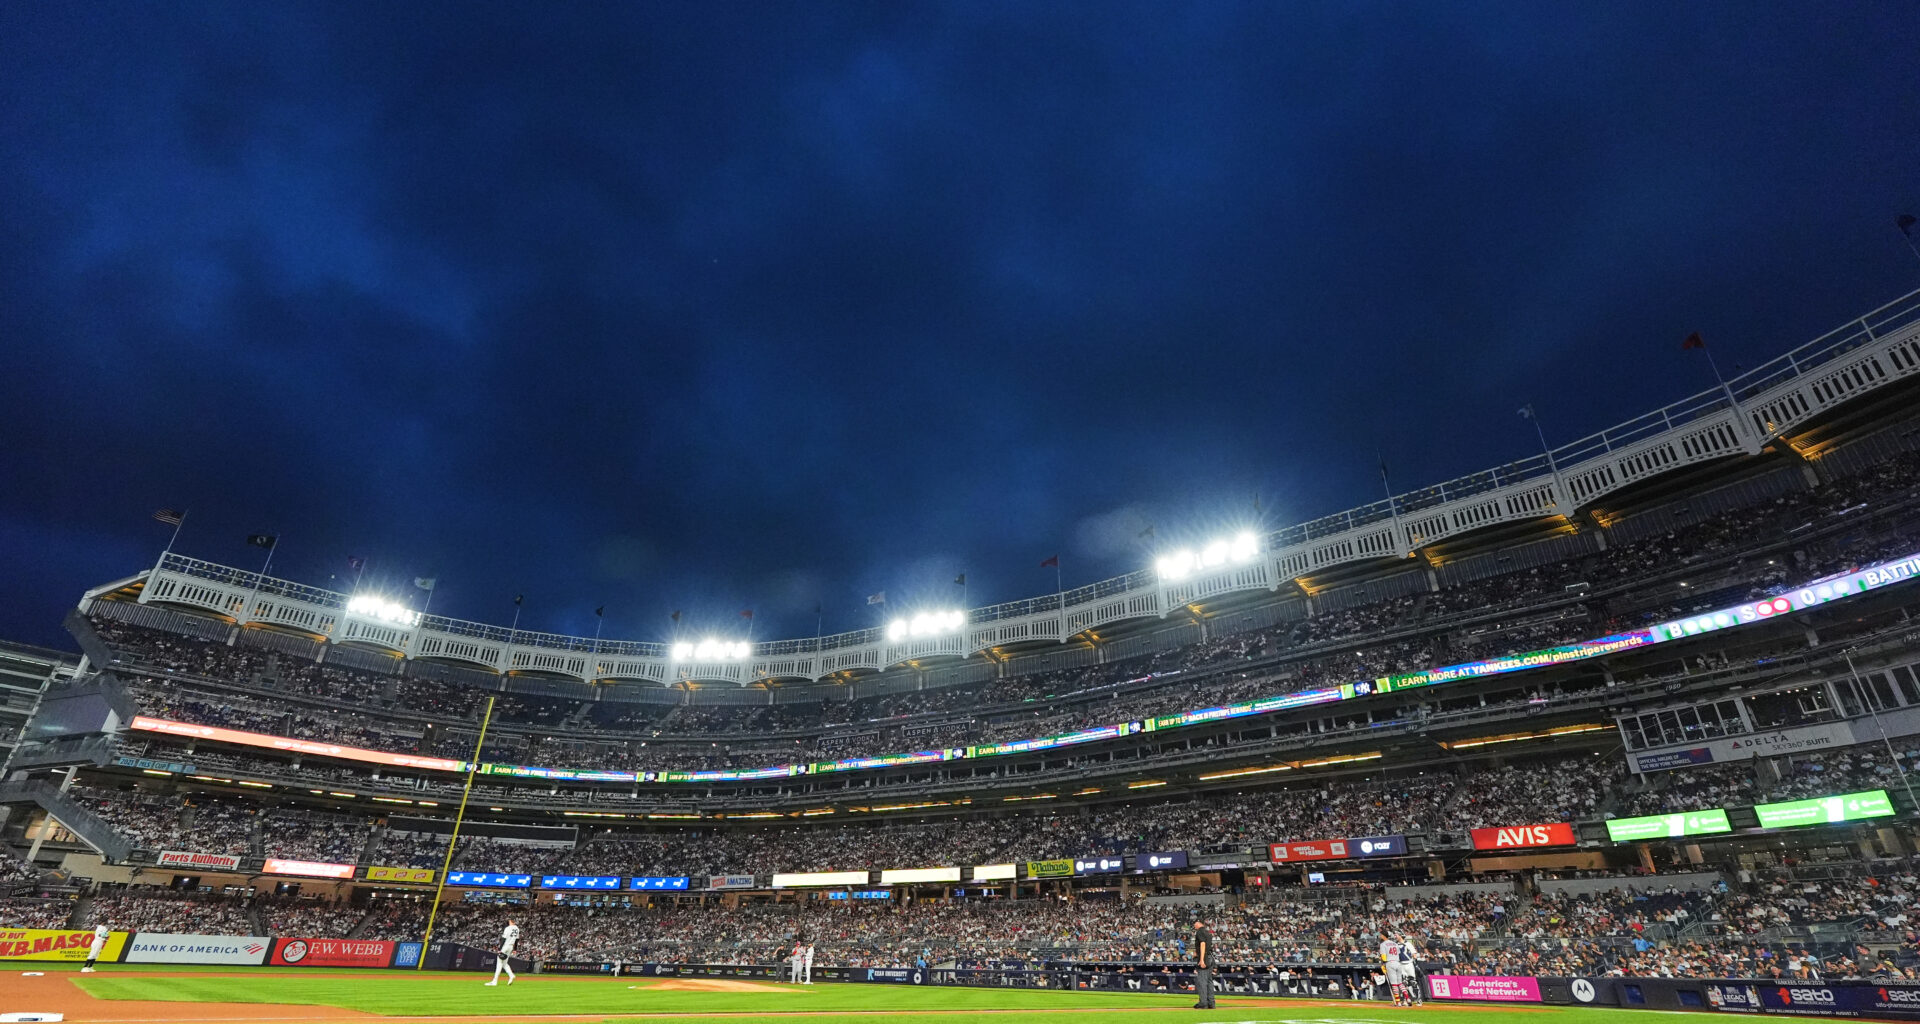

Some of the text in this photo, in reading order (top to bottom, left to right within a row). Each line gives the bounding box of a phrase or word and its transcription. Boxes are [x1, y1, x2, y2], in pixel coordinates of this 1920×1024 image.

[1741, 606, 1756, 621] S
[1668, 623, 1682, 638] B
[1397, 635, 1643, 687] LEARN MORE AT YANKEES.COM/pinstriperewards
[906, 724, 966, 736] ASPEN VODKA
[821, 738, 845, 746] ASPEN
[1745, 735, 1788, 747] DELTA
[1805, 737, 1831, 746] SUITE
[120, 758, 134, 766] 2021
[1496, 826, 1550, 846] AVIS
[162, 853, 189, 863] Parts
[190, 853, 236, 866] Authority
[1031, 860, 1071, 874] Nathan's
[727, 877, 752, 885] AMAZING
[133, 944, 167, 952] BANK
[186, 945, 239, 954] AMERICA
[309, 942, 384, 955] F.W. WEBB
[1468, 979, 1518, 988] America's
[1486, 987, 1528, 996] Network
[1723, 993, 1746, 1001] LEGACY
[1790, 988, 1834, 1002] sato
